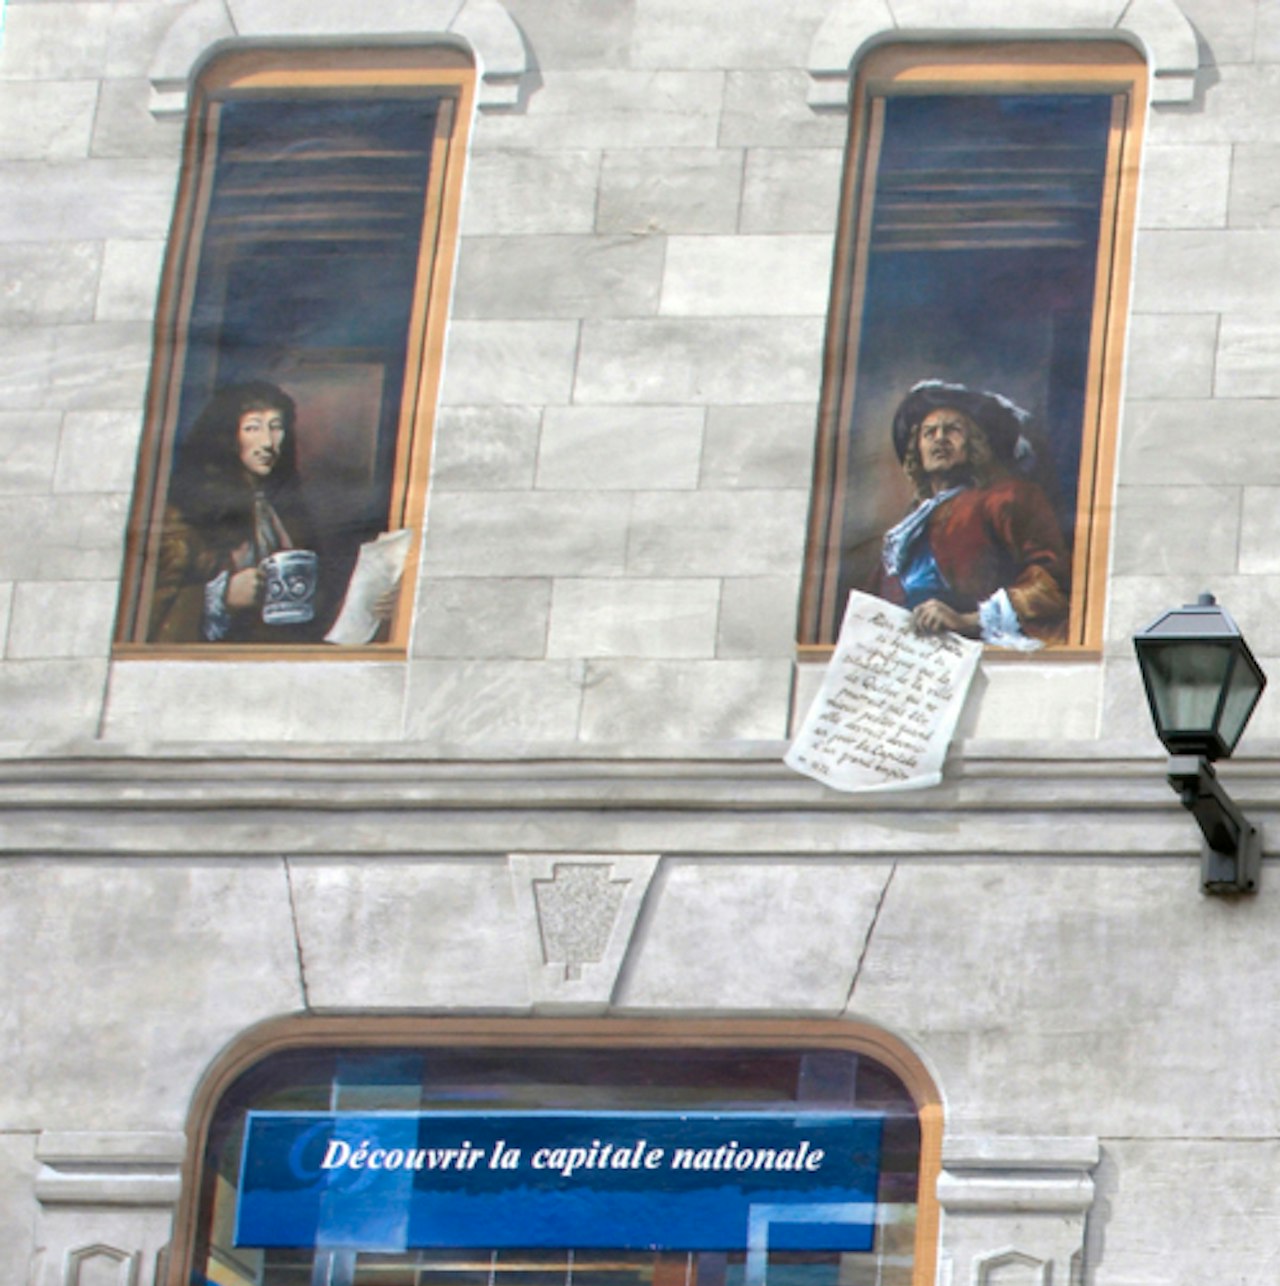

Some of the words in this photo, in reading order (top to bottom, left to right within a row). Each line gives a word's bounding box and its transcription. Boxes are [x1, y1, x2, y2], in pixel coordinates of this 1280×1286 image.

[321, 1139, 485, 1170] Découvrir
[488, 1140, 522, 1170] la
[531, 1139, 664, 1177] capitale
[670, 1140, 825, 1171] nationale
